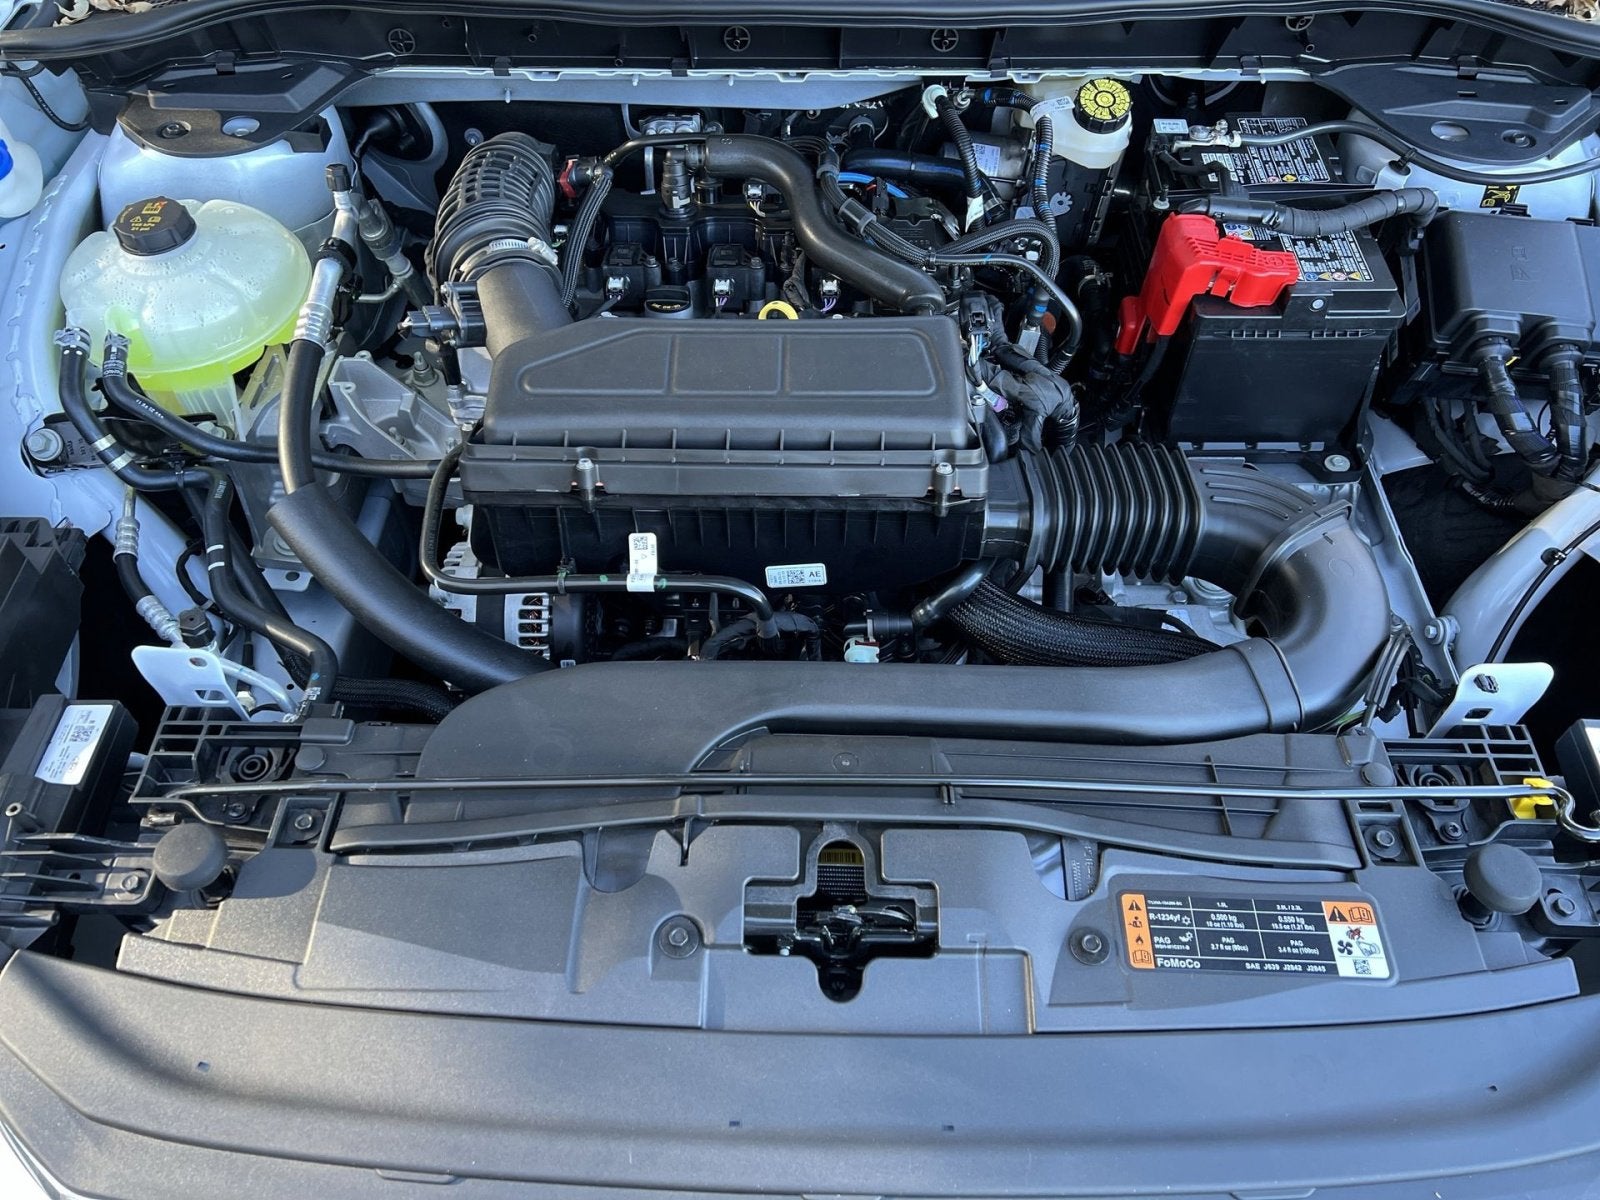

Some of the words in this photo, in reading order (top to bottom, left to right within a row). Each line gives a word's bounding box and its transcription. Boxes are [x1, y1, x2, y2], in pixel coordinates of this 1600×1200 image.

[1148, 912, 1181, 923] R-1234yf
[1210, 913, 1228, 921] 0.500
[1228, 914, 1238, 923] kg
[1277, 915, 1296, 923] 0.550
[1295, 916, 1305, 925] kg
[1153, 936, 1171, 944] PAG
[1221, 936, 1235, 944] PAG
[1157, 957, 1201, 969] FoMoCo
[1245, 962, 1261, 970] SAE
[1263, 963, 1280, 971] J639
[1283, 963, 1303, 972] J2842
